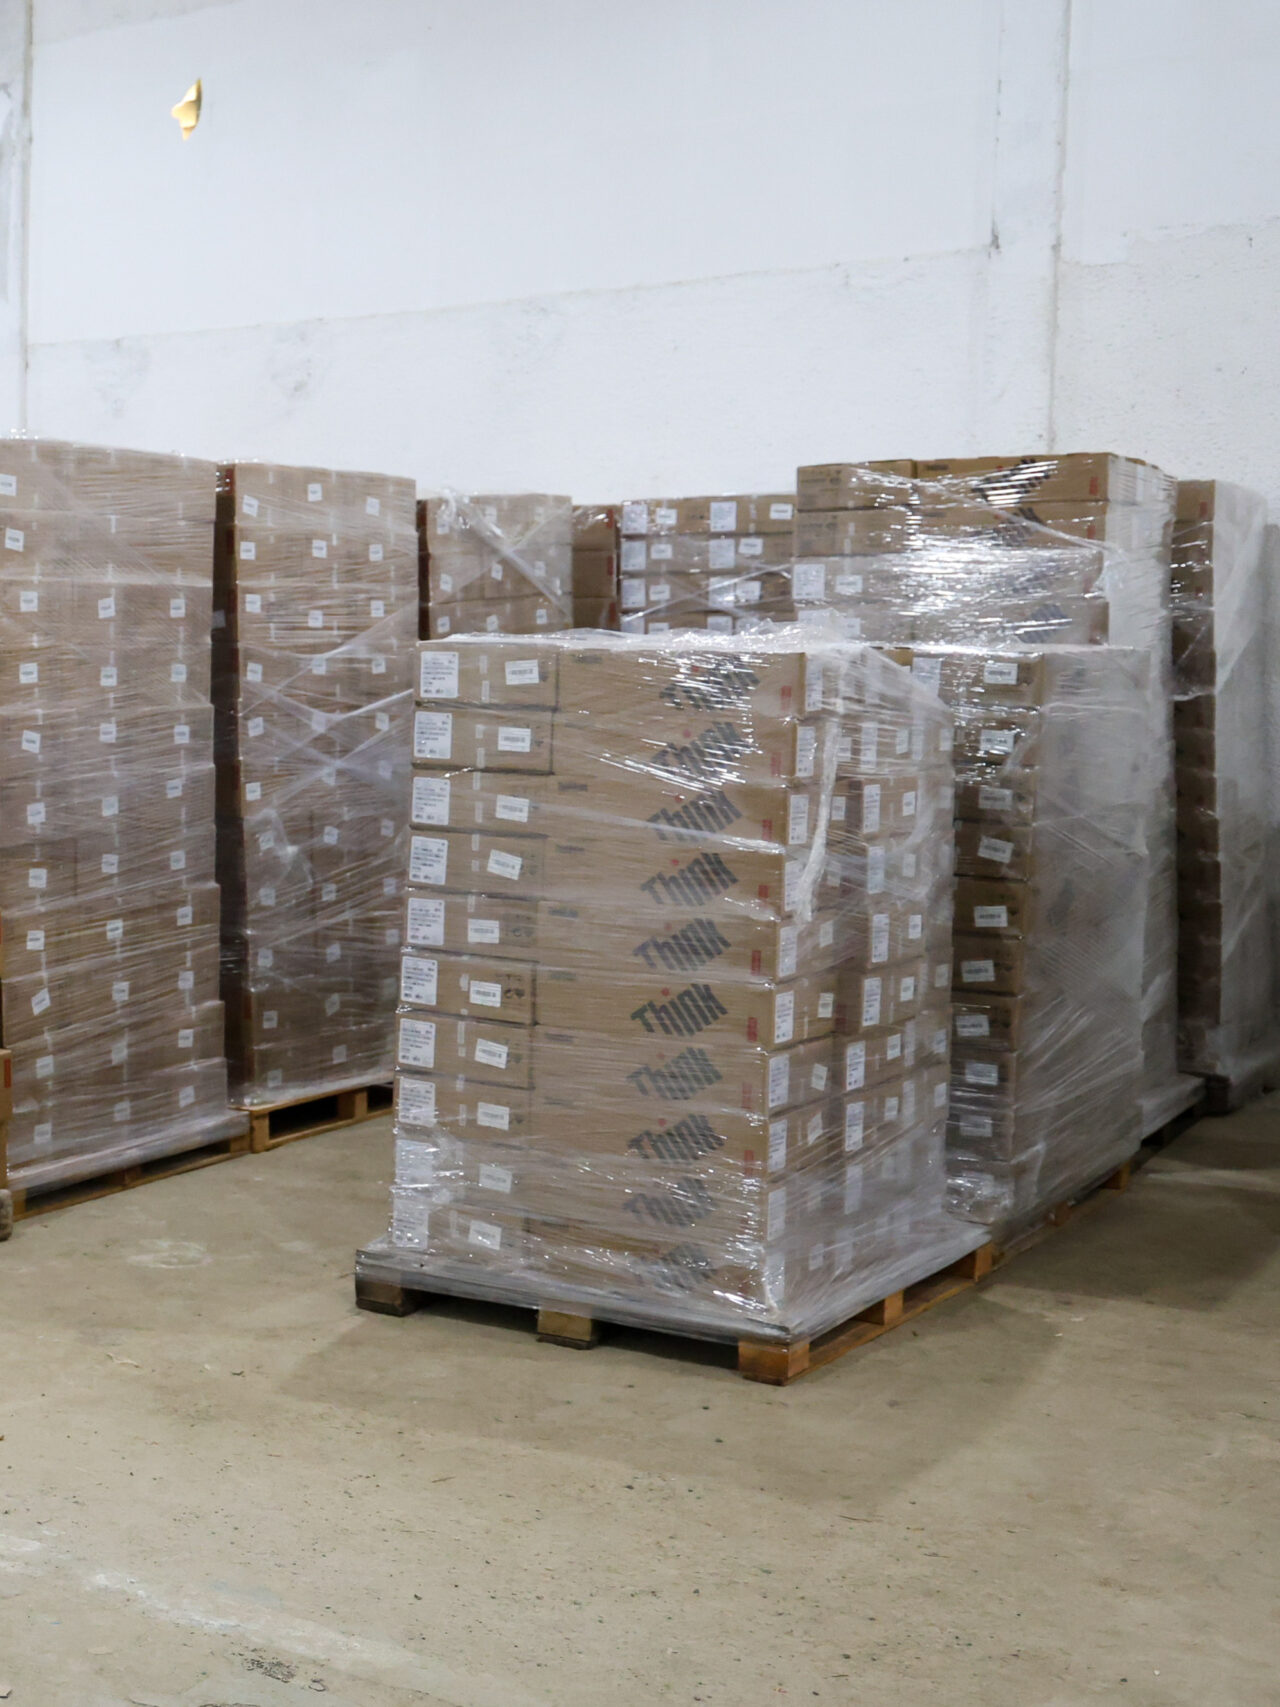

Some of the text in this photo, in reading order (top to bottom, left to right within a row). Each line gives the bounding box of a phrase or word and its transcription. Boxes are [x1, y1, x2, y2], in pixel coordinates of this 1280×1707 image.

[646, 789, 743, 843] Think
[640, 852, 739, 907] Think
[632, 918, 732, 972] Think
[630, 983, 728, 1037] Think
[625, 1046, 723, 1101] Think
[627, 1113, 725, 1164] Think
